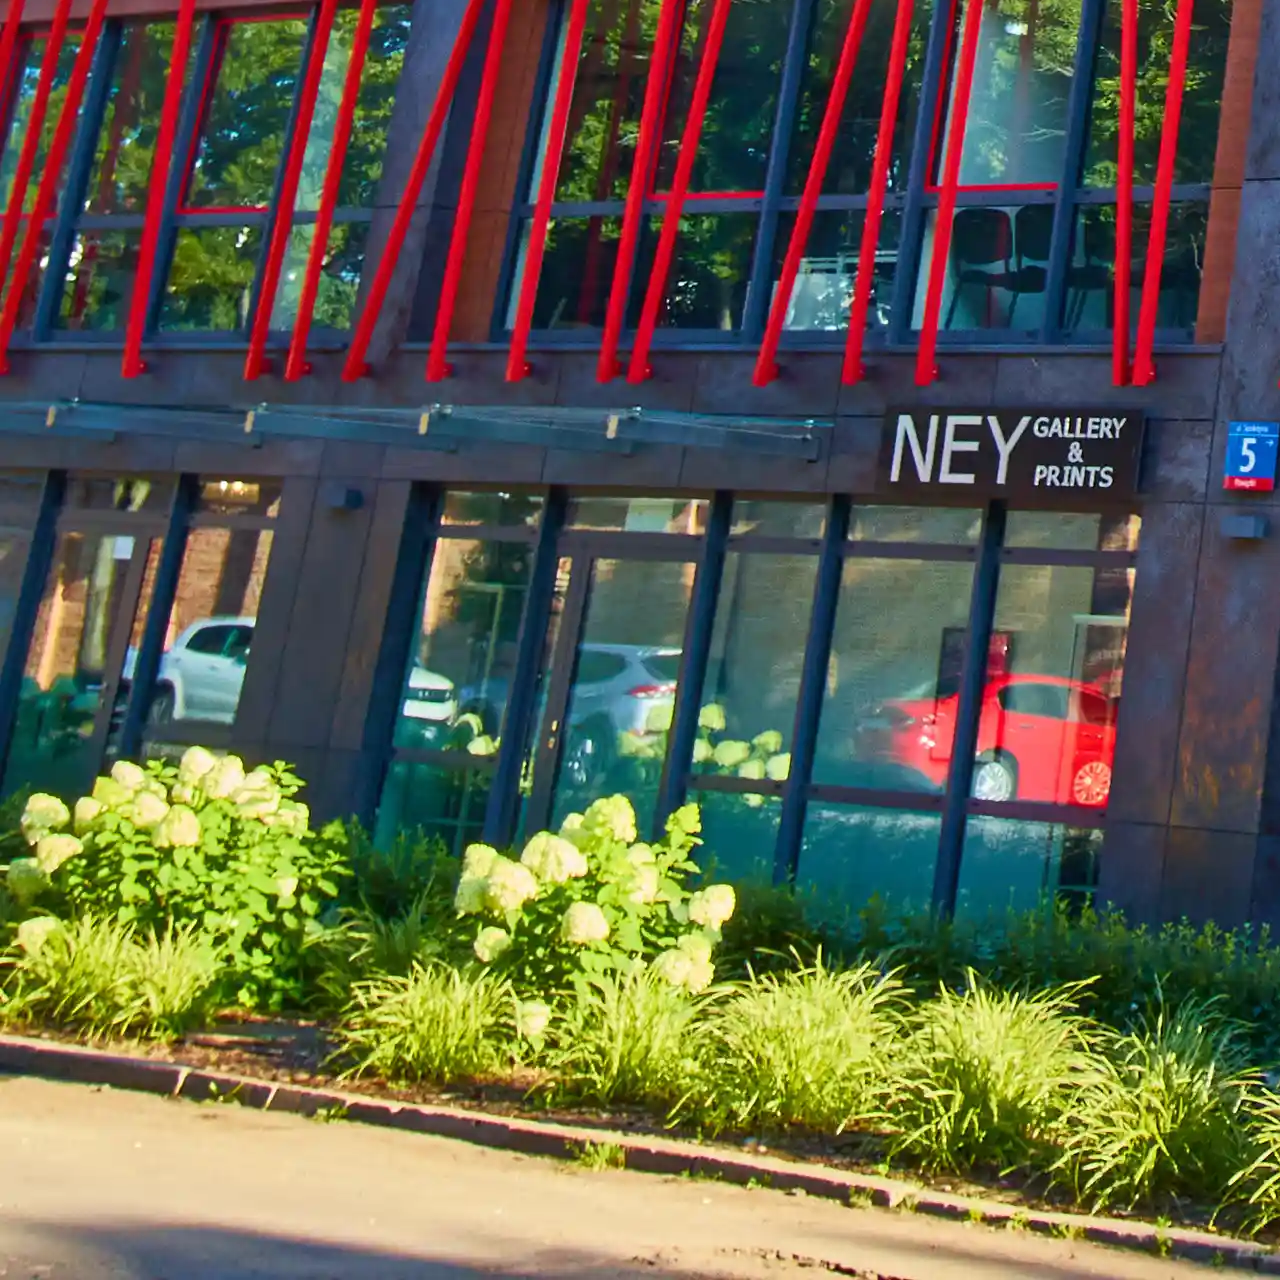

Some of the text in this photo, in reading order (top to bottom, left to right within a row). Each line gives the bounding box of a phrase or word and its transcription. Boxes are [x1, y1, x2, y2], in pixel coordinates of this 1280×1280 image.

[1033, 416, 1127, 439] GALLERY
[890, 414, 1032, 485] NEY
[1067, 441, 1084, 463] &
[1239, 437, 1257, 473] 5
[1033, 464, 1114, 488] PRINTS
